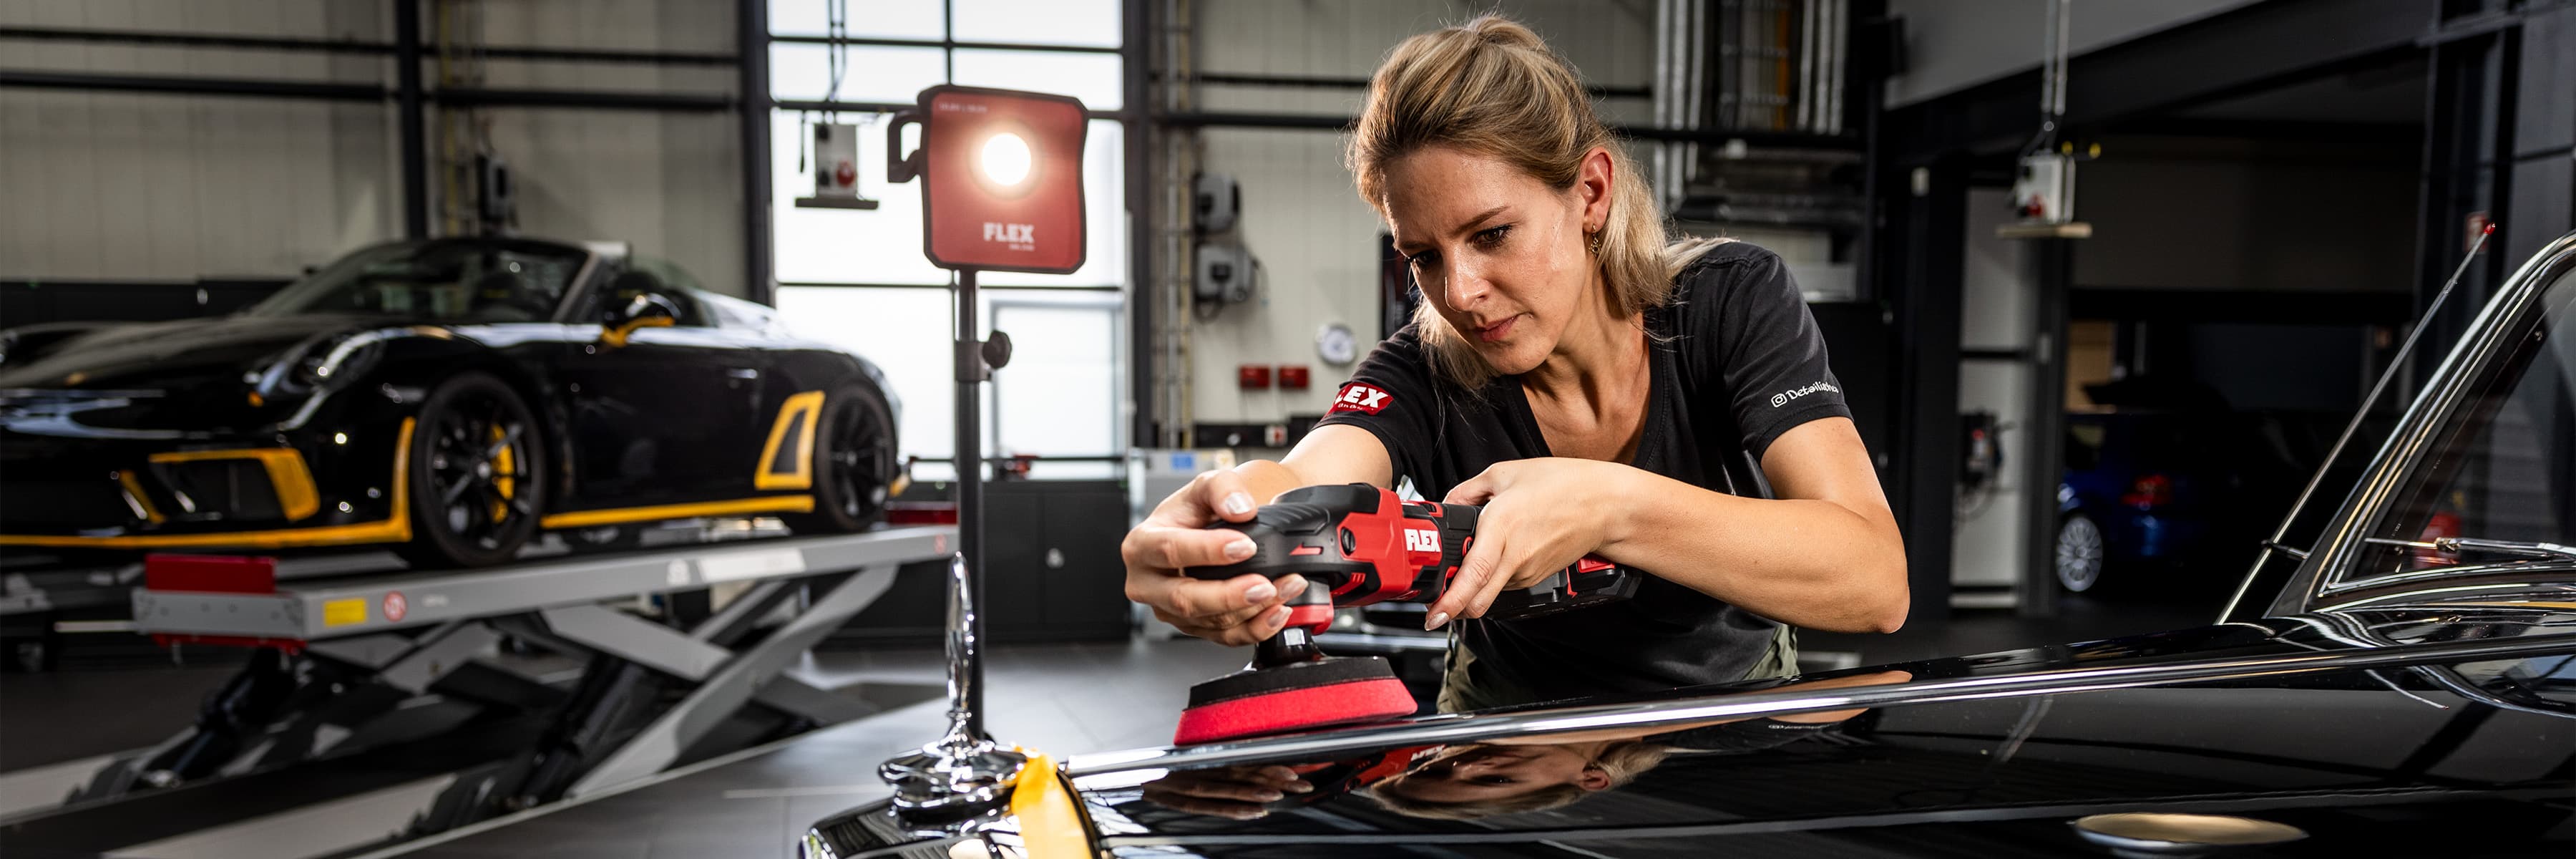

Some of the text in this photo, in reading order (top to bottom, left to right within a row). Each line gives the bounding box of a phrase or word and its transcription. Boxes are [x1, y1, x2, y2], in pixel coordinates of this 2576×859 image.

[984, 222, 1035, 243] FLEX
[1335, 385, 1388, 408] LEX
[1404, 528, 1441, 552] FLEX
